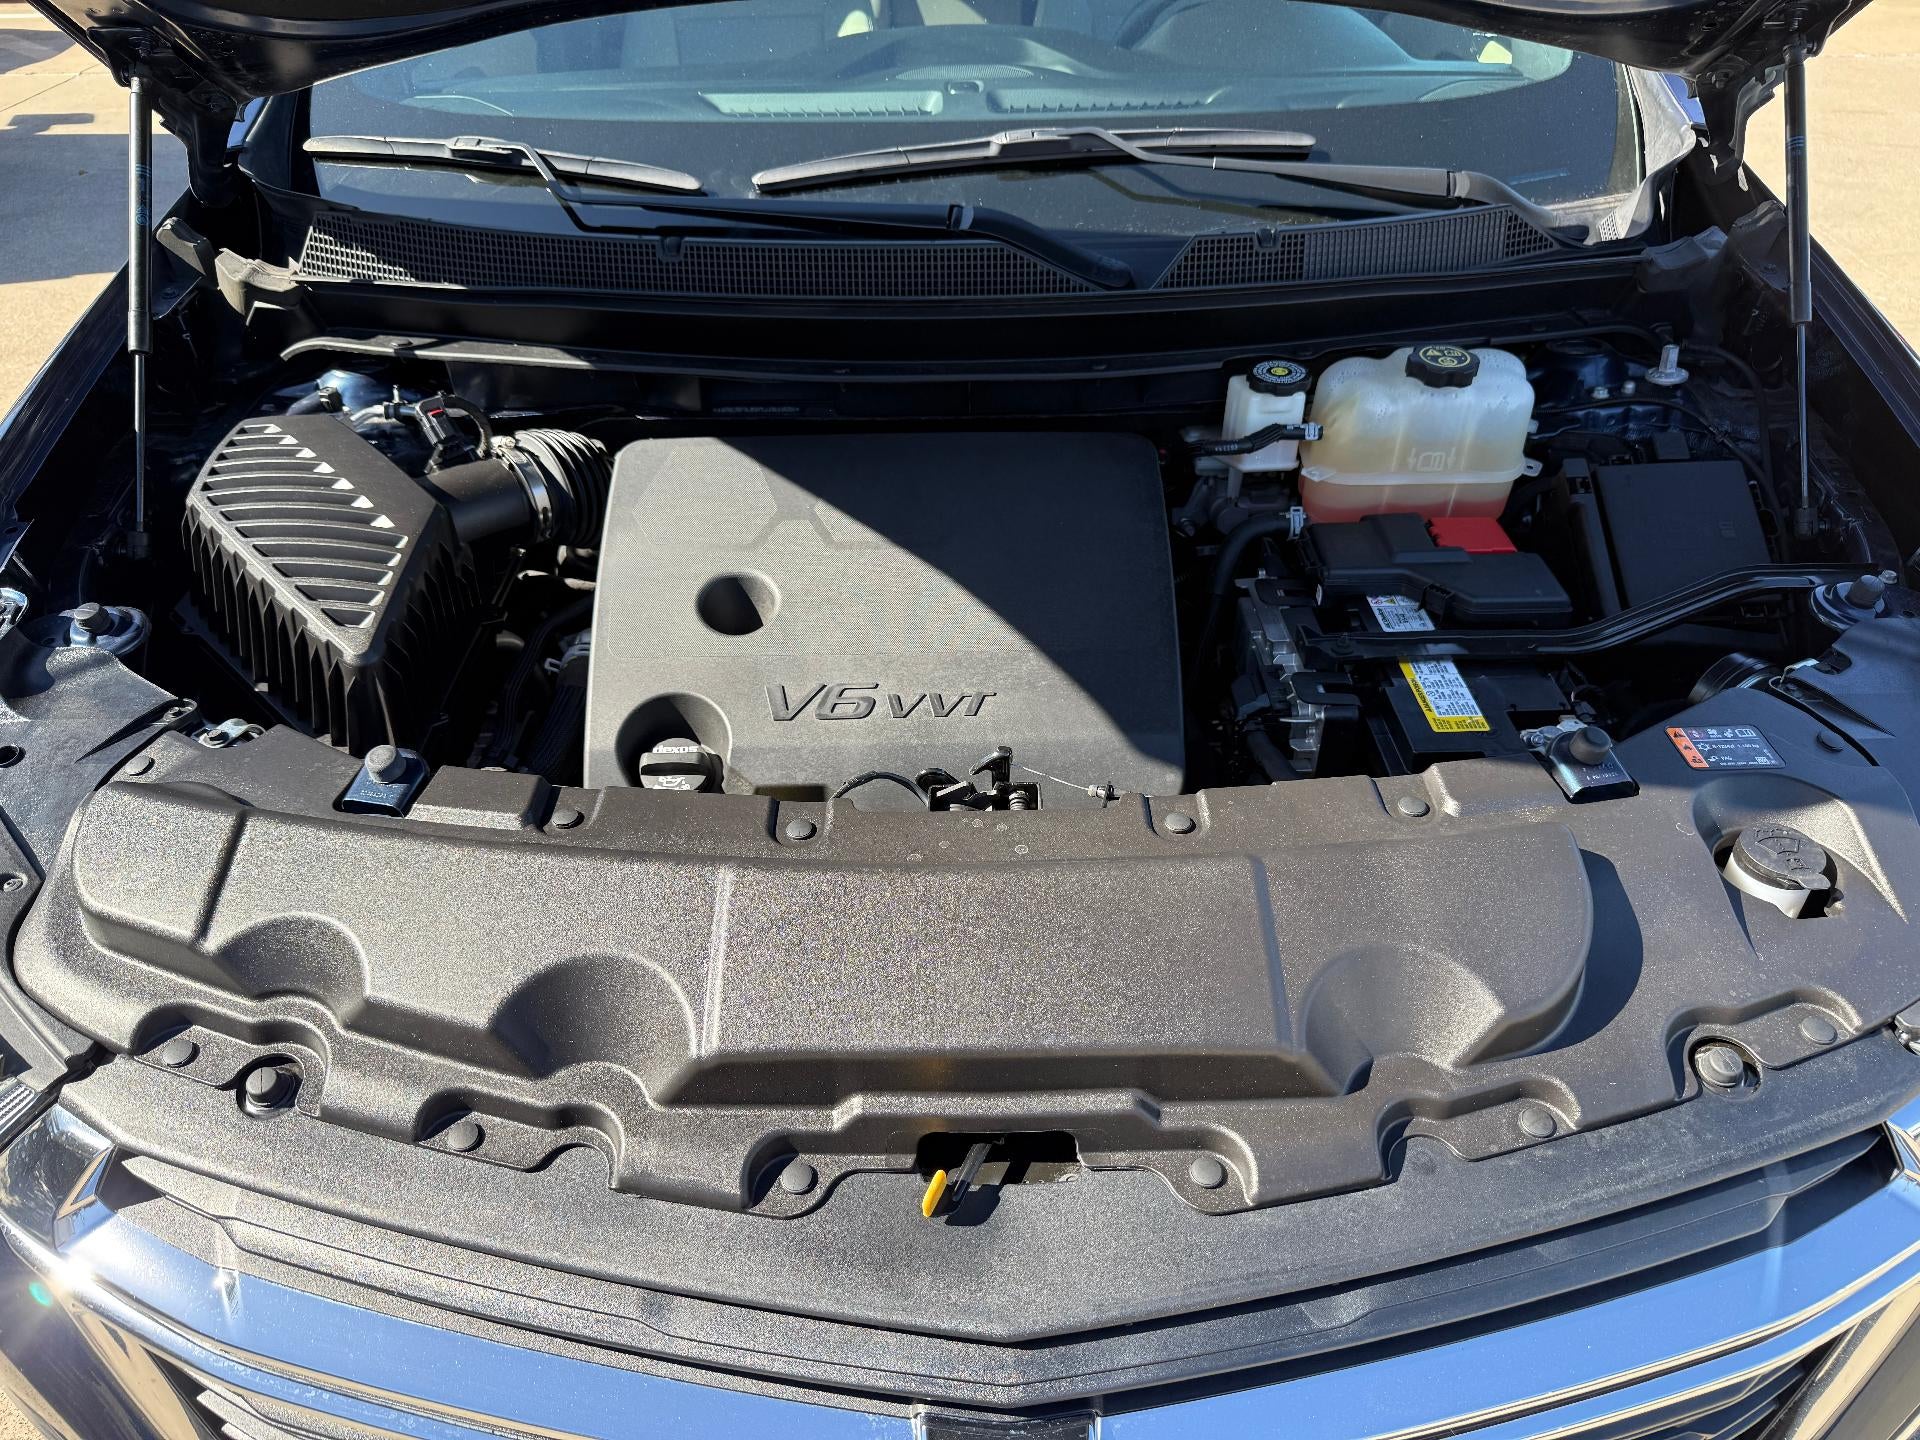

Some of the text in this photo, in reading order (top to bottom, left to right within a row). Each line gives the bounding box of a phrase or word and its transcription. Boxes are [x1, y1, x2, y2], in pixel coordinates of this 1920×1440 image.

[764, 682, 997, 721] V6 VVT
[652, 744, 698, 753] dexos
